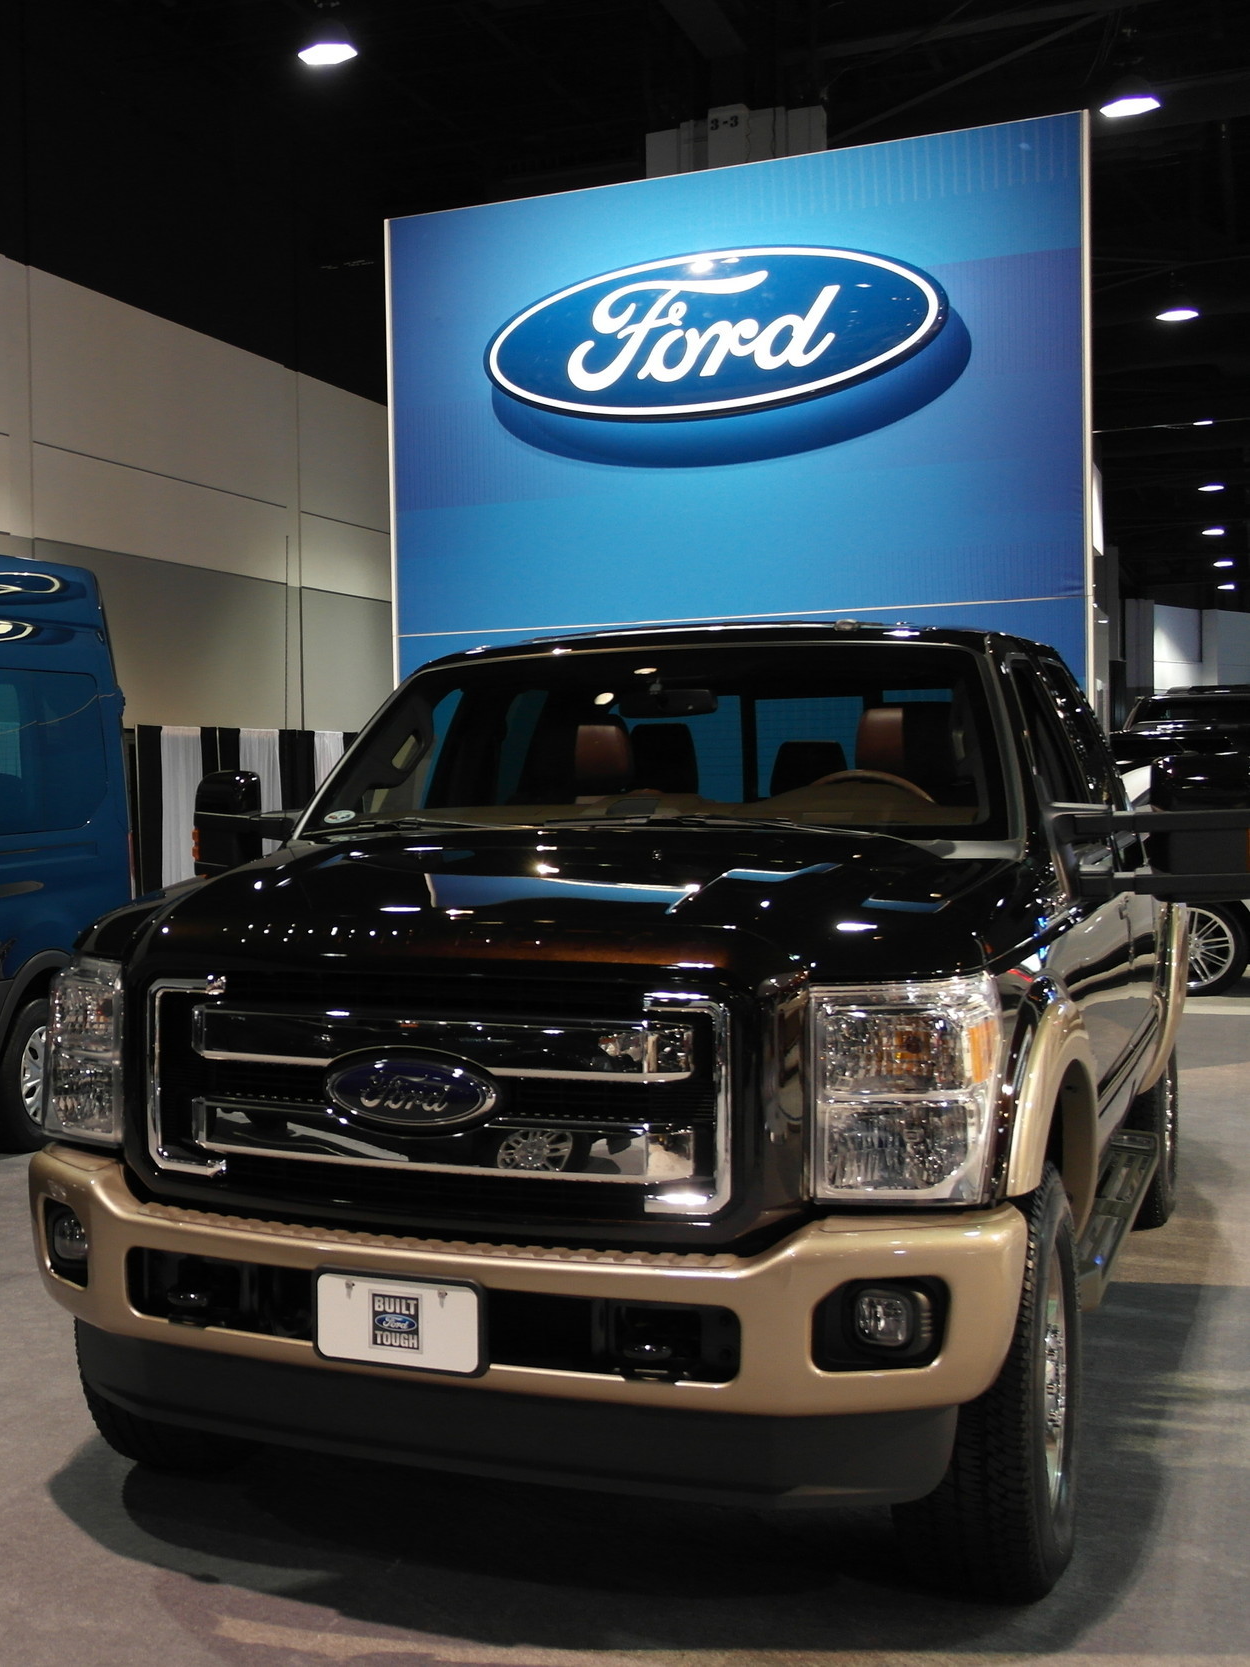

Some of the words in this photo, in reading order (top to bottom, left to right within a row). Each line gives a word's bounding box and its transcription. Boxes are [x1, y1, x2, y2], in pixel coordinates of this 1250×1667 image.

[710, 115, 739, 131] 3-3
[566, 269, 841, 393] Ford
[360, 1071, 450, 1113] Ford
[373, 1295, 418, 1315] BUILT
[382, 1315, 410, 1330] Ford
[374, 1330, 418, 1349] TOUGH
